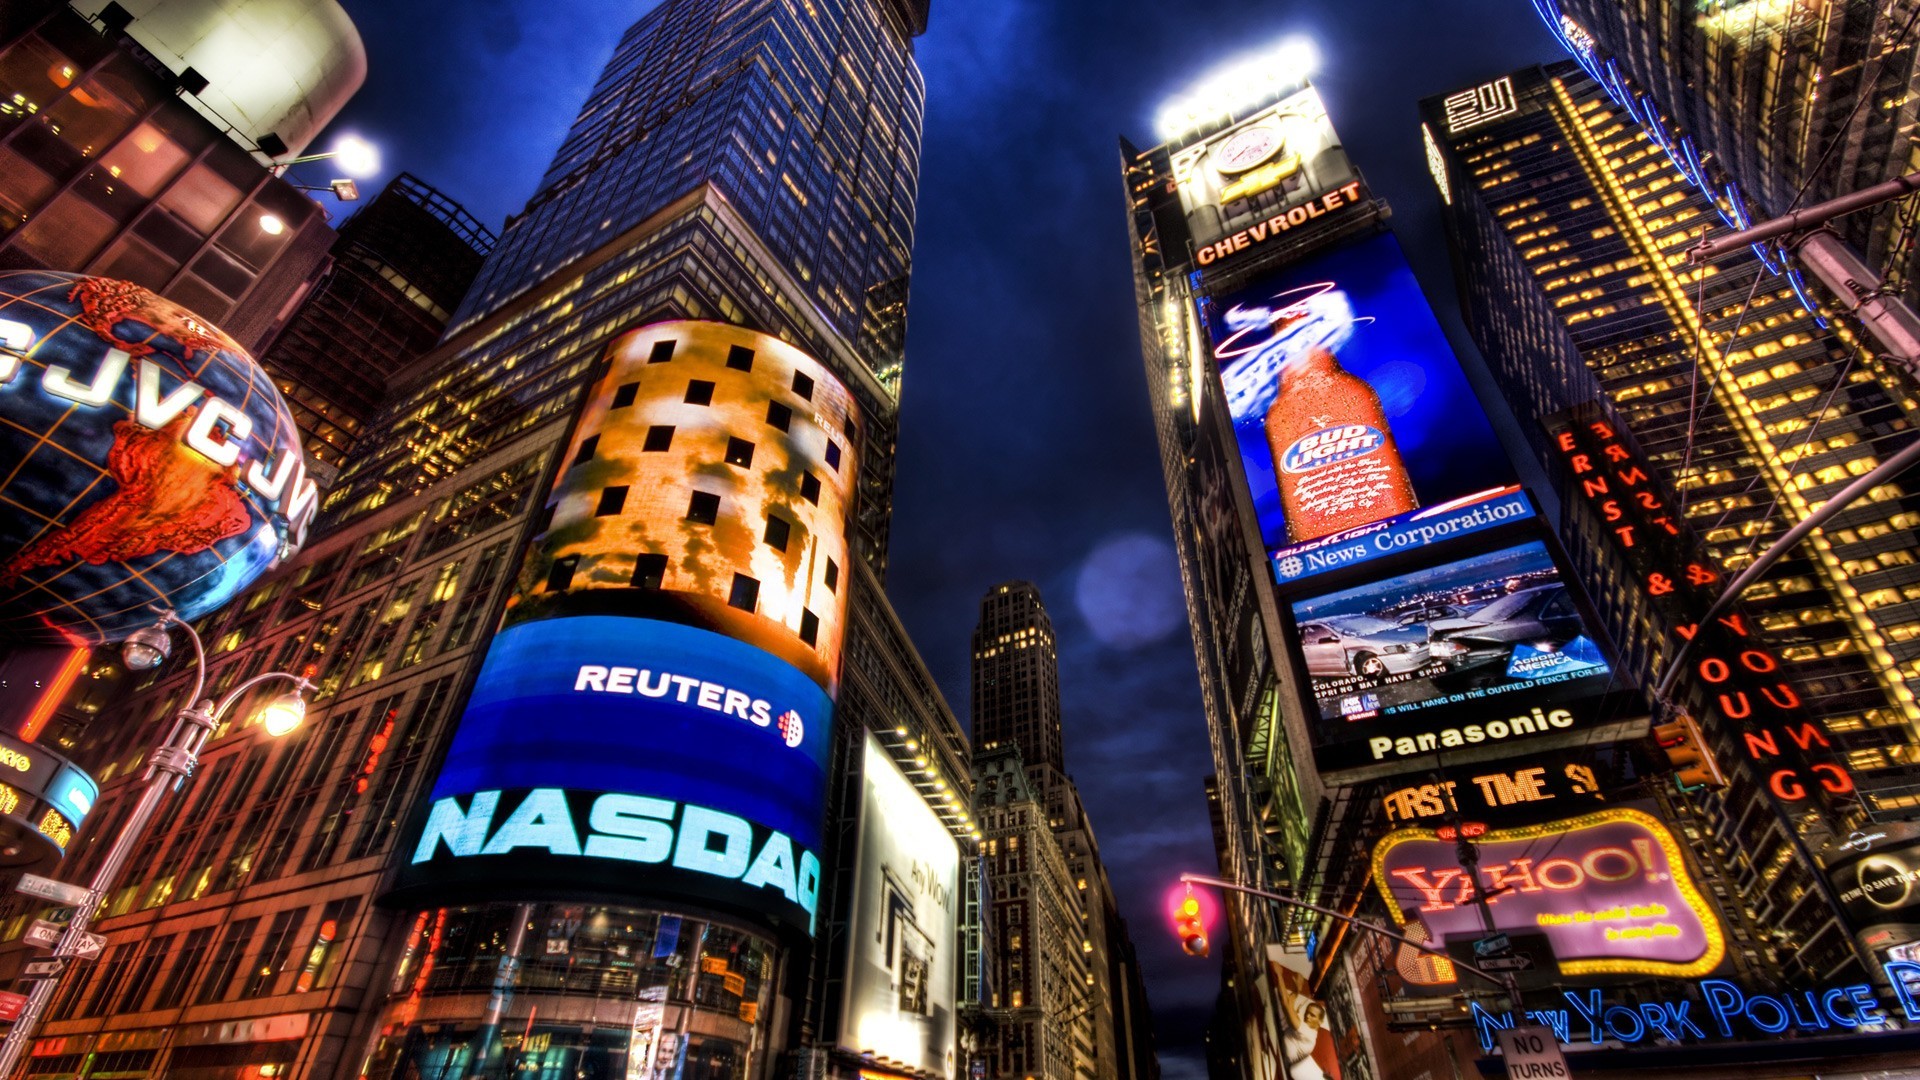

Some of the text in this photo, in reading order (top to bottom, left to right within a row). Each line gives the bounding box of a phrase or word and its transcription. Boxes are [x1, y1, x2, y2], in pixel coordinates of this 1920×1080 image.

[1197, 181, 1360, 265] CHEVROLET
[41, 347, 253, 467] JVC
[1290, 435, 1378, 470] LIGHT
[1298, 425, 1368, 453] BUD
[1558, 432, 1635, 549] ERNST
[1647, 571, 1675, 597] &
[1307, 501, 1527, 570] News Corporation
[1509, 655, 1573, 674] AMERICA
[1513, 651, 1564, 666] ACROSS
[574, 664, 772, 728] REUTERS
[1313, 675, 1367, 692] COLORADO.
[1359, 680, 1379, 691] MAY
[1385, 673, 1412, 684] HAVE
[1398, 702, 1422, 714] WILL
[1422, 698, 1448, 709] HANG
[1450, 693, 1465, 703] ON
[1466, 689, 1485, 700] THE
[1487, 680, 1534, 695] OUTFIELD
[1536, 673, 1570, 686] FENCE
[1571, 668, 1593, 680] FOR
[1348, 710, 1376, 721] channel
[1369, 707, 1575, 760] Panasonic
[1382, 781, 1459, 822] FIRST
[1472, 767, 1556, 807] TIME
[1438, 824, 1487, 839] VACNCY
[411, 788, 821, 938] NASDAQ
[1391, 838, 1657, 913] YAHOO!
[1872, 876, 1896, 893] SAVE
[1564, 989, 1706, 1045] YORK
[1701, 979, 1887, 1038] POLICE
[1513, 1035, 1544, 1055] NO
[1510, 1061, 1566, 1079] TURNS
